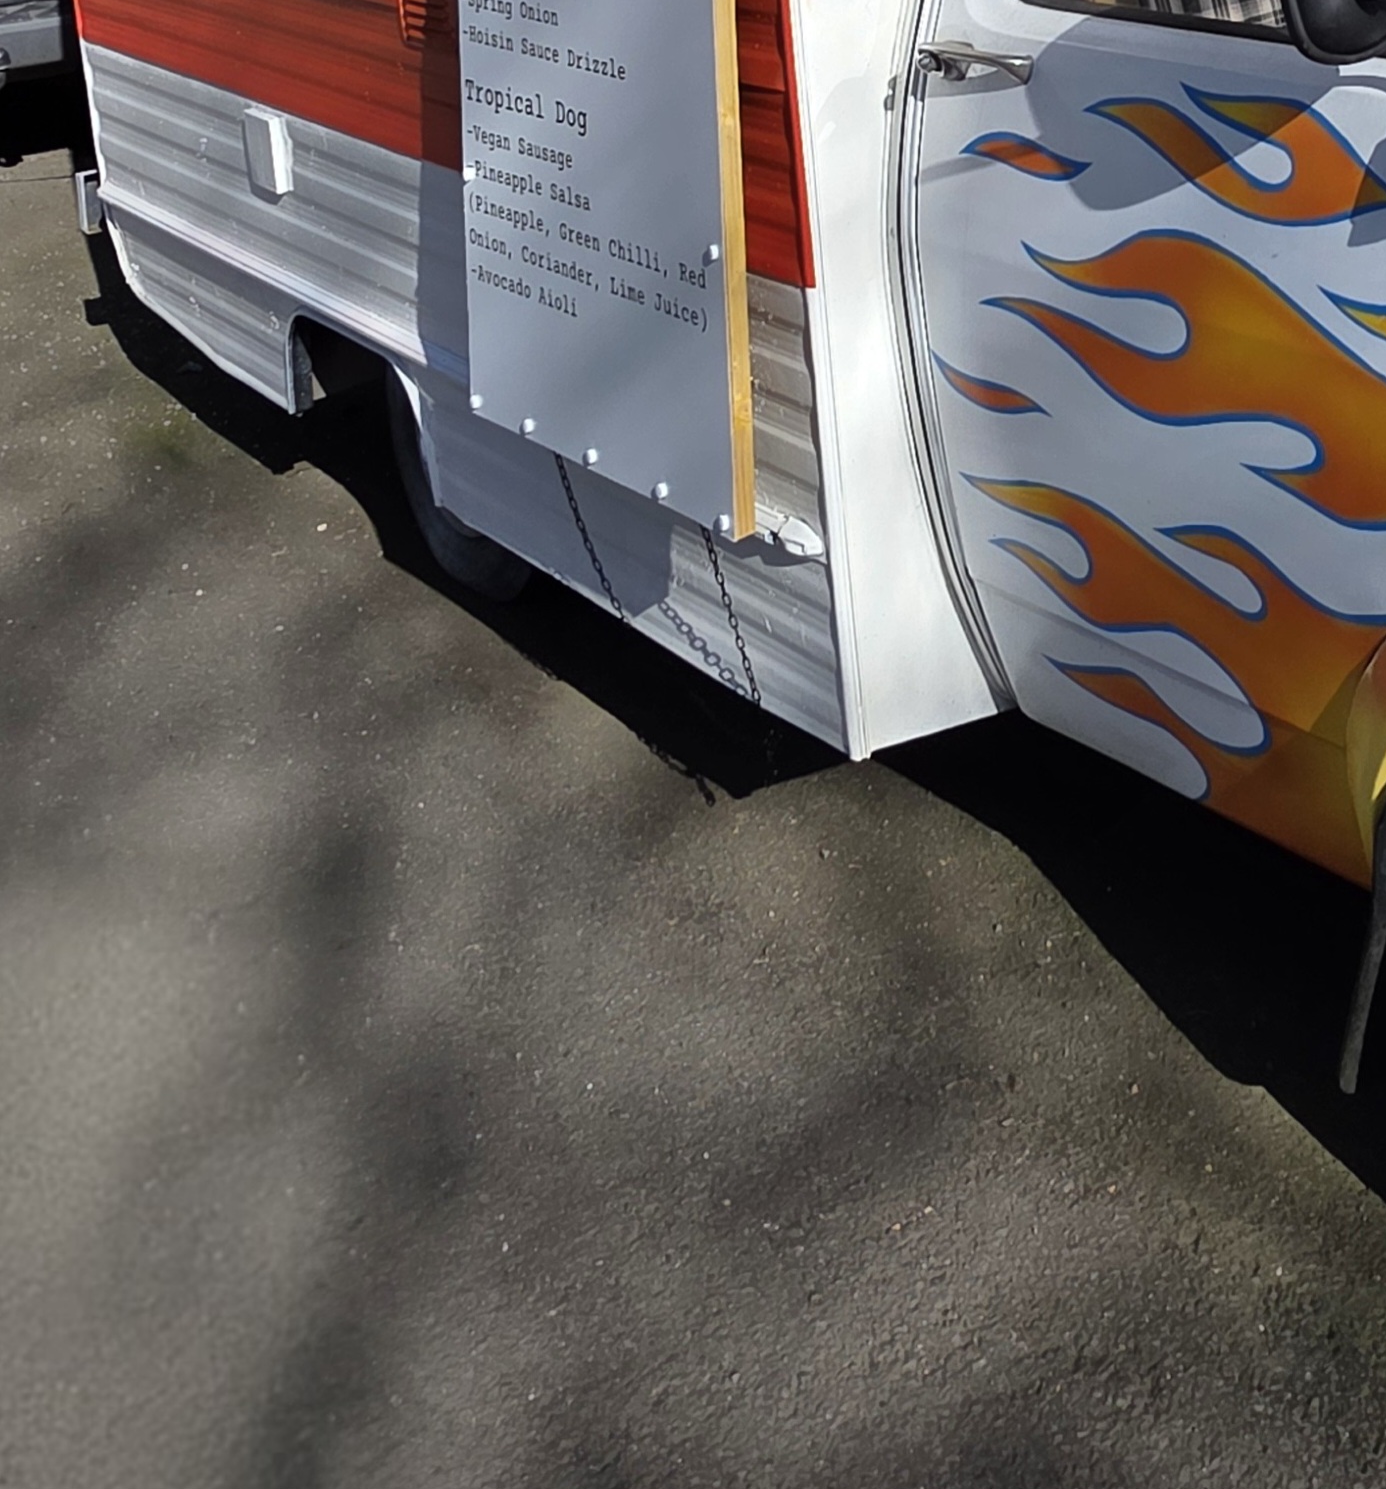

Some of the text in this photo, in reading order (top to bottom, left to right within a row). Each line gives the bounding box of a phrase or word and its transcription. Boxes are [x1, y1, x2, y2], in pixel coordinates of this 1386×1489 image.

[520, 3, 559, 27] Onion
[462, 25, 626, 81] -Hoisin Sauce Drizzle
[465, 79, 588, 137] Tropical Dog
[467, 125, 573, 172] -Vegan Sausage
[466, 160, 591, 212] -Pineapple Salsa
[469, 191, 706, 290] (Pineapple, Green Chilli, Red
[469, 228, 709, 333] Onion, Coriander, Lime Juice)
[471, 265, 578, 319] -Avocado Aioli
